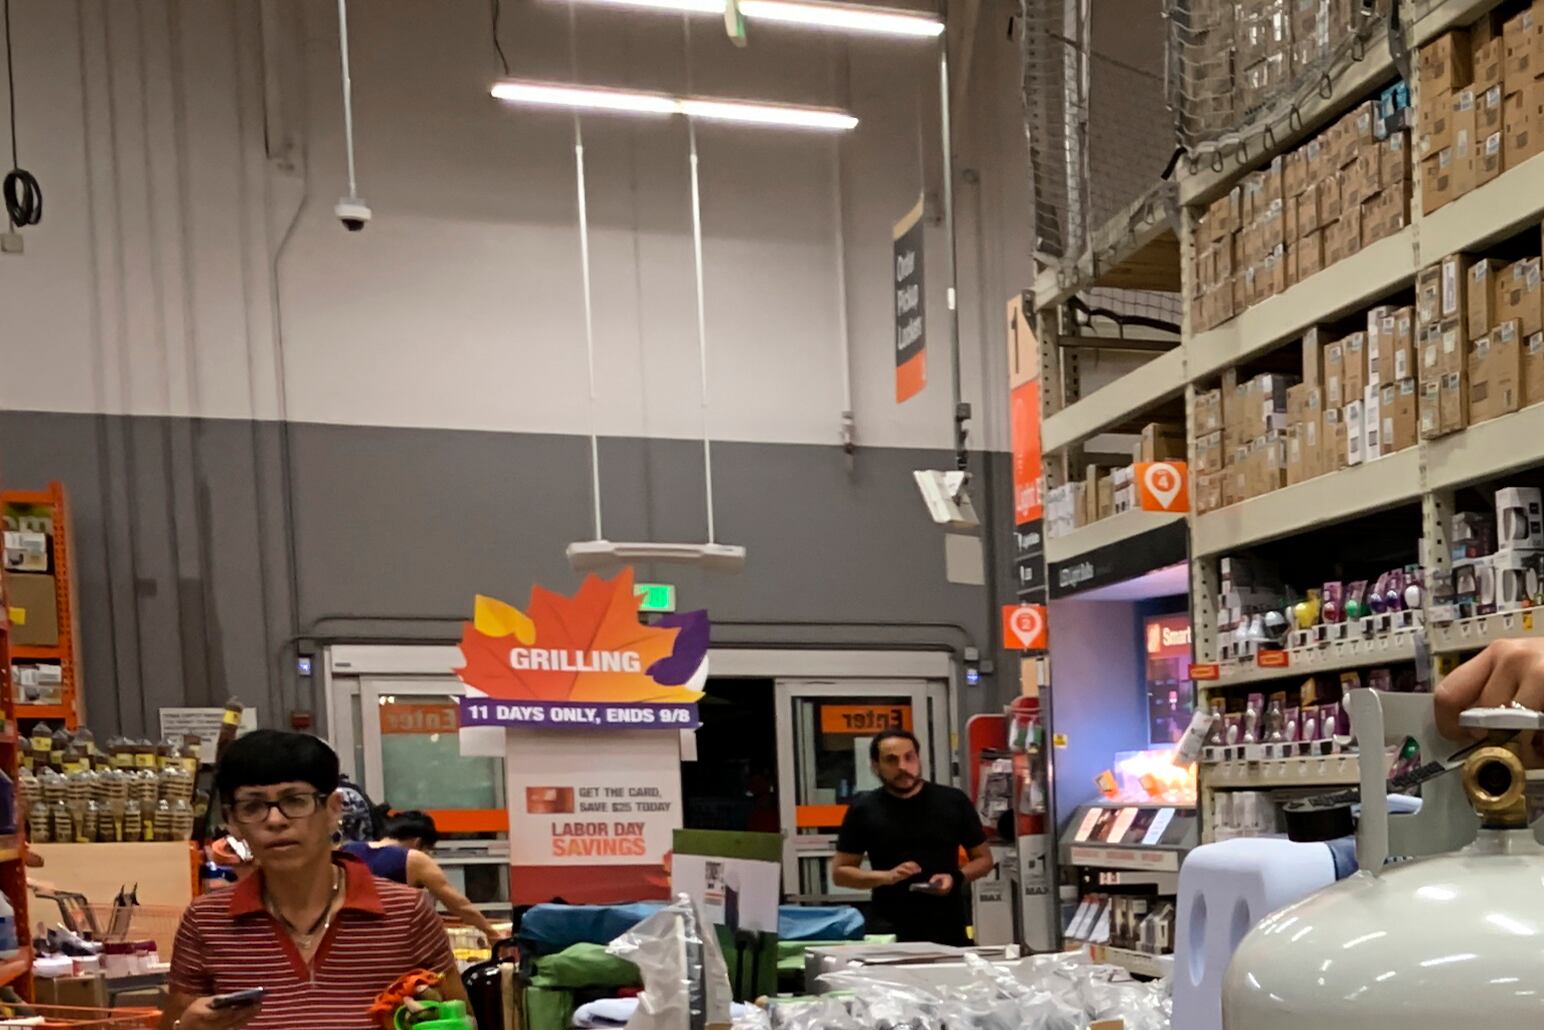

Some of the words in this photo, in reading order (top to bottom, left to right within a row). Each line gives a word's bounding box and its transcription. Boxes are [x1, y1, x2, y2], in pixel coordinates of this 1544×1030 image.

[510, 647, 641, 673] GRILLING
[468, 705, 488, 721] 11
[496, 705, 545, 722] DAYS
[550, 706, 600, 724] ONLY,
[606, 707, 655, 723] ENDS
[659, 707, 690, 723] 9/8
[579, 786, 602, 798] GET
[606, 786, 625, 798] THE
[579, 801, 608, 813] SAVE
[636, 801, 672, 812] TODAY
[552, 822, 608, 837] LABOR
[613, 822, 645, 837] DAY
[552, 838, 646, 857] SAVINGS
